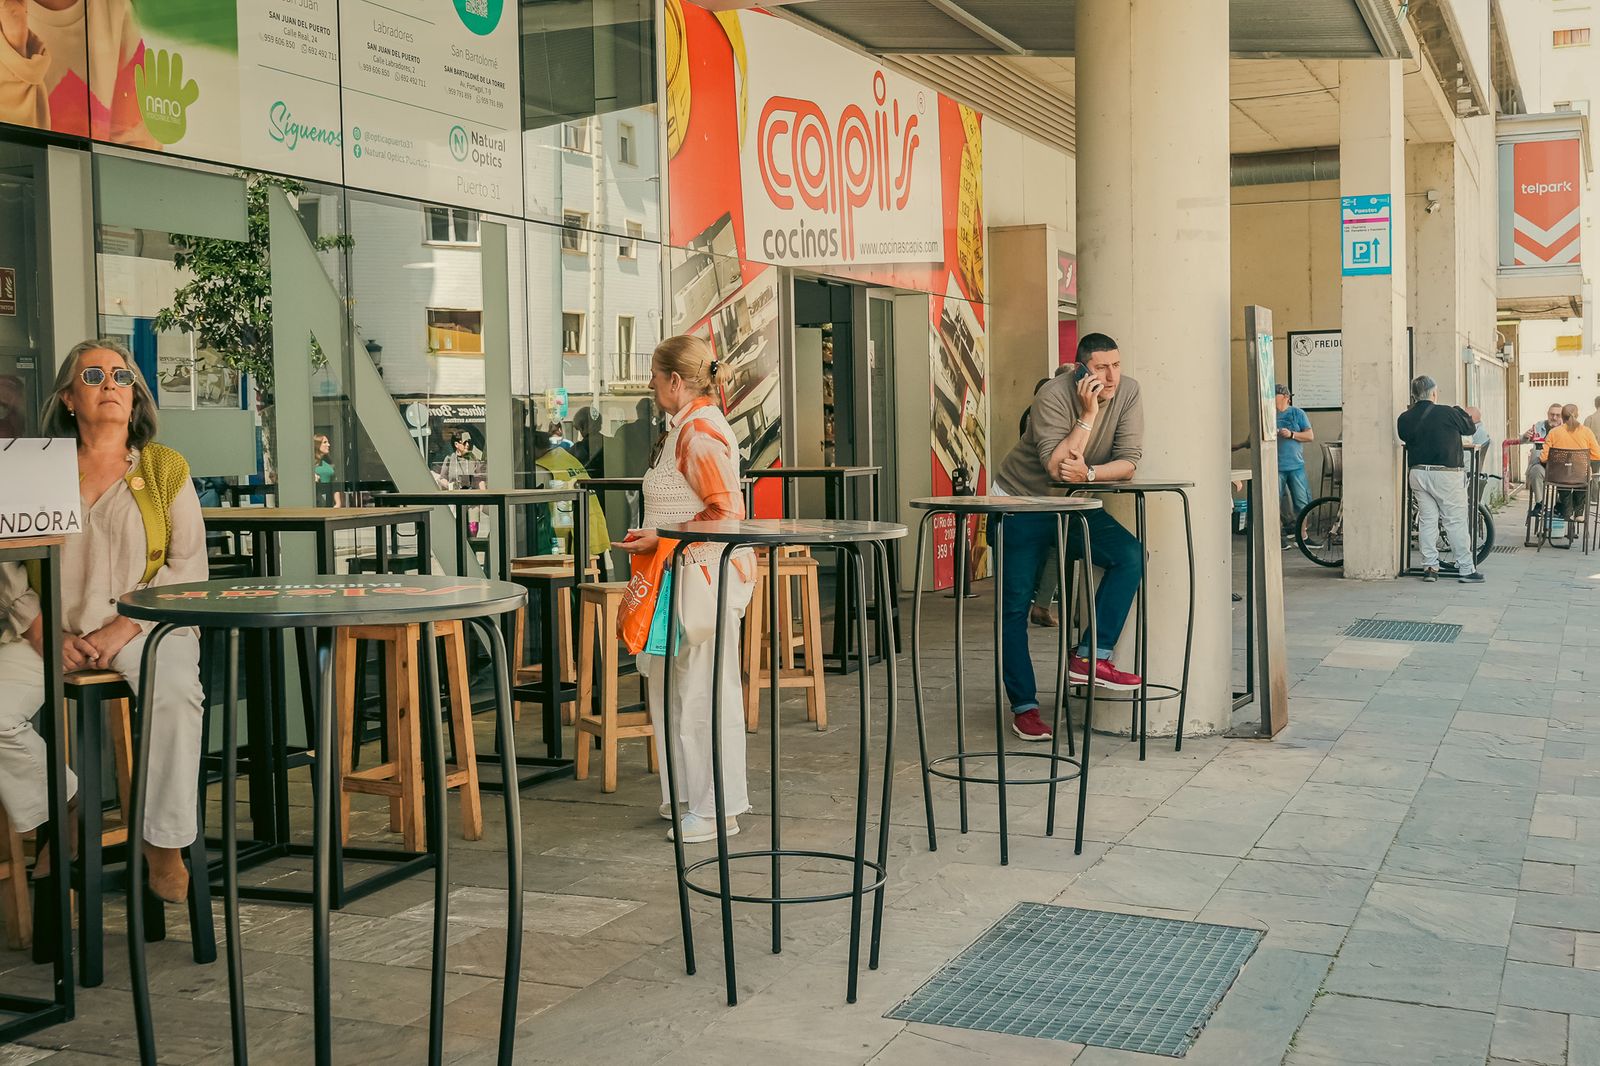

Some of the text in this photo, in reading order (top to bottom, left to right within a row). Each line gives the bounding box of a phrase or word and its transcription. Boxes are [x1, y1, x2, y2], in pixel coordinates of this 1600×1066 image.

[269, 10, 331, 36] SAN JUAN DEL PUERTO
[283, 27, 297, 38] Calle
[373, 18, 414, 43] Labradores
[367, 42, 420, 64] SAN JUAN DEL PUERTO
[451, 44, 498, 69] San Bartolomé
[444, 65, 453, 73] SAN
[454, 67, 479, 81] BARTOLOMÉ
[492, 79, 505, 89] TORRE
[268, 100, 342, 151] Síguenos
[471, 131, 506, 152] Natural
[365, 146, 386, 160] Natural
[387, 152, 405, 163] Optics
[472, 149, 502, 168] Optics
[457, 176, 500, 199] Puerto 31
[1521, 181, 1572, 195] telpark
[763, 219, 838, 260] cocinas
[1355, 243, 1367, 258] P
[0, 510, 80, 533] NDORA
